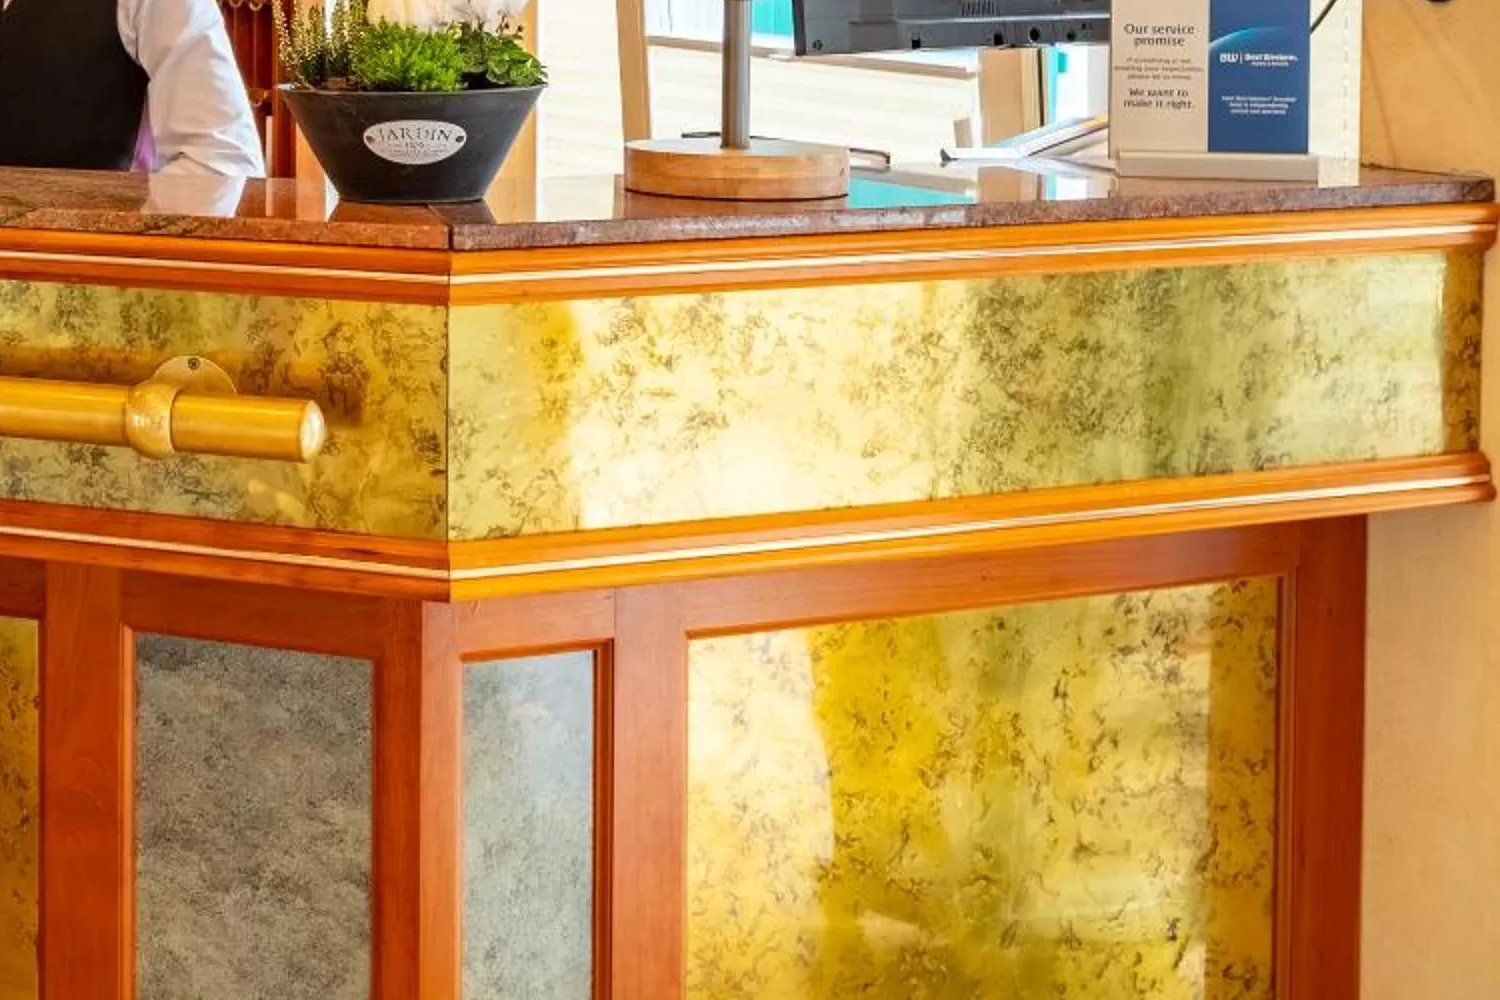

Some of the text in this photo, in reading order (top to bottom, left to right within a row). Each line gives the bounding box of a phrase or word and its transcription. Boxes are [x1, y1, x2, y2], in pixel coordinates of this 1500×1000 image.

[1123, 23, 1195, 34] Our service
[1134, 37, 1185, 47] promise
[1129, 87, 1145, 96] We
[1123, 99, 1153, 108] make
[1155, 100, 1163, 108] it
